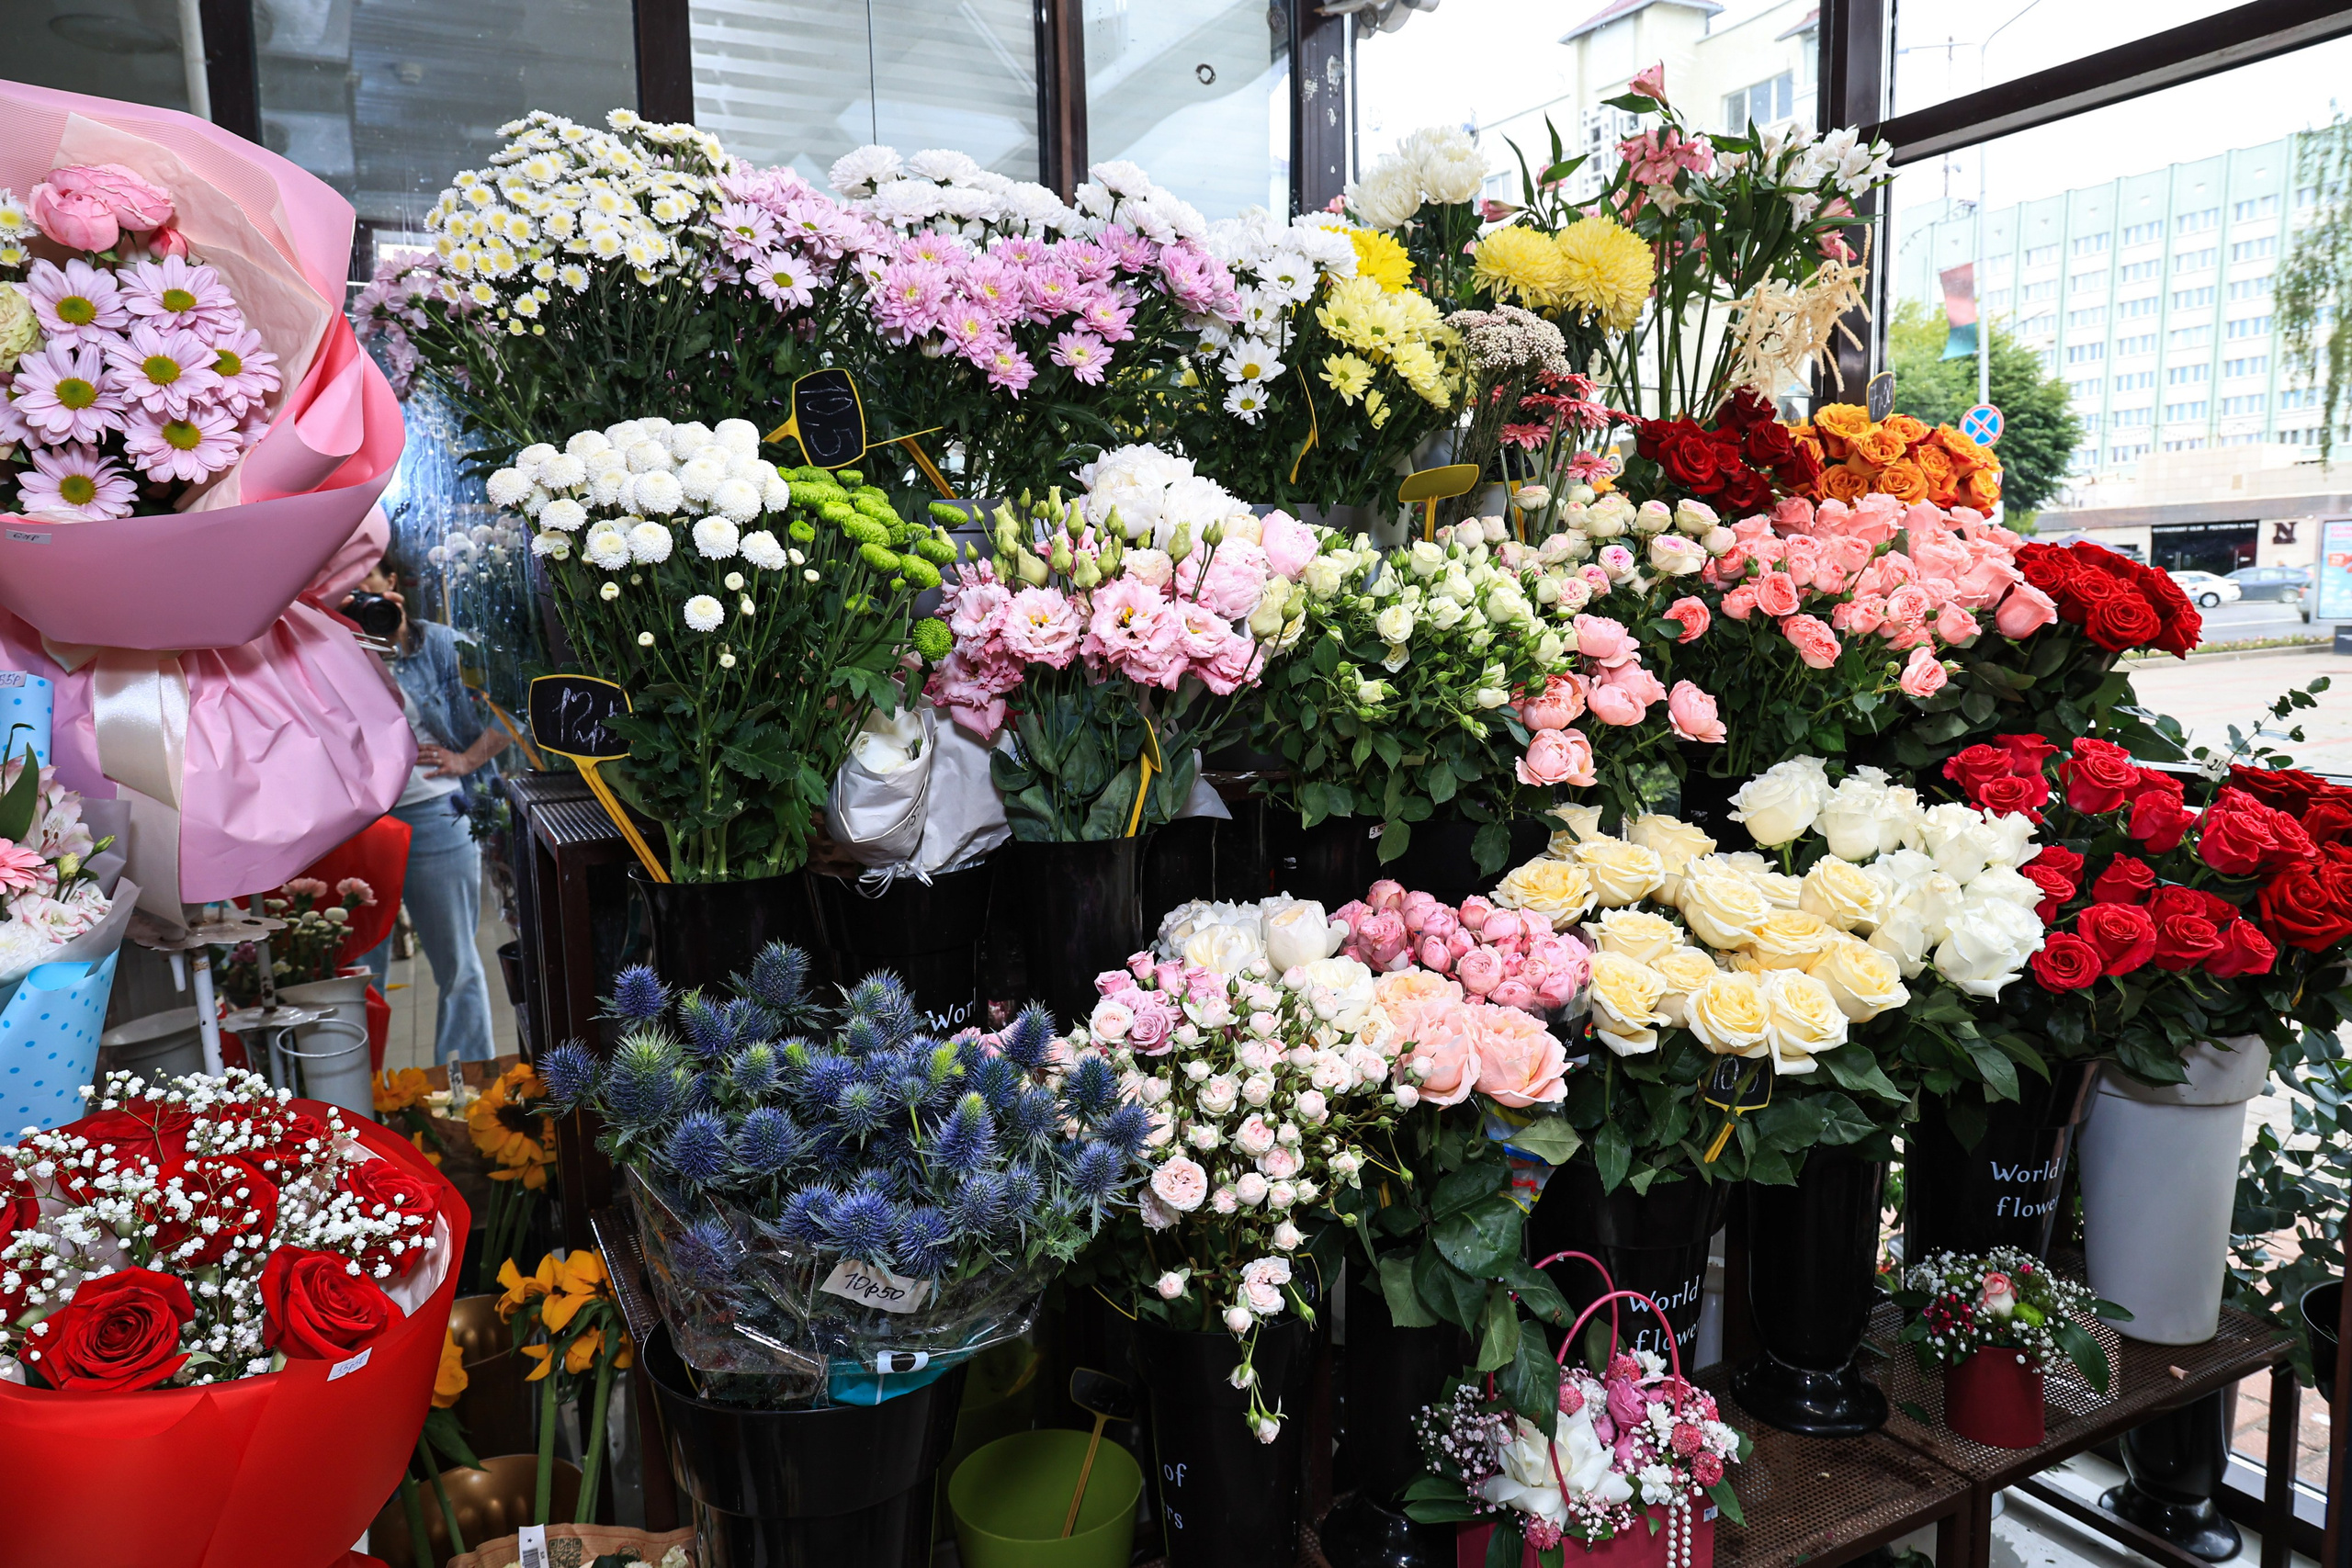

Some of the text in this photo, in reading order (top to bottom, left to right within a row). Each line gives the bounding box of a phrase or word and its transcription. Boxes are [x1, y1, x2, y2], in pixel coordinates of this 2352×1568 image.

[1990, 1157, 2061, 1182] World
[1628, 1274, 1700, 1313] World
[1163, 1462, 1187, 1487] of
